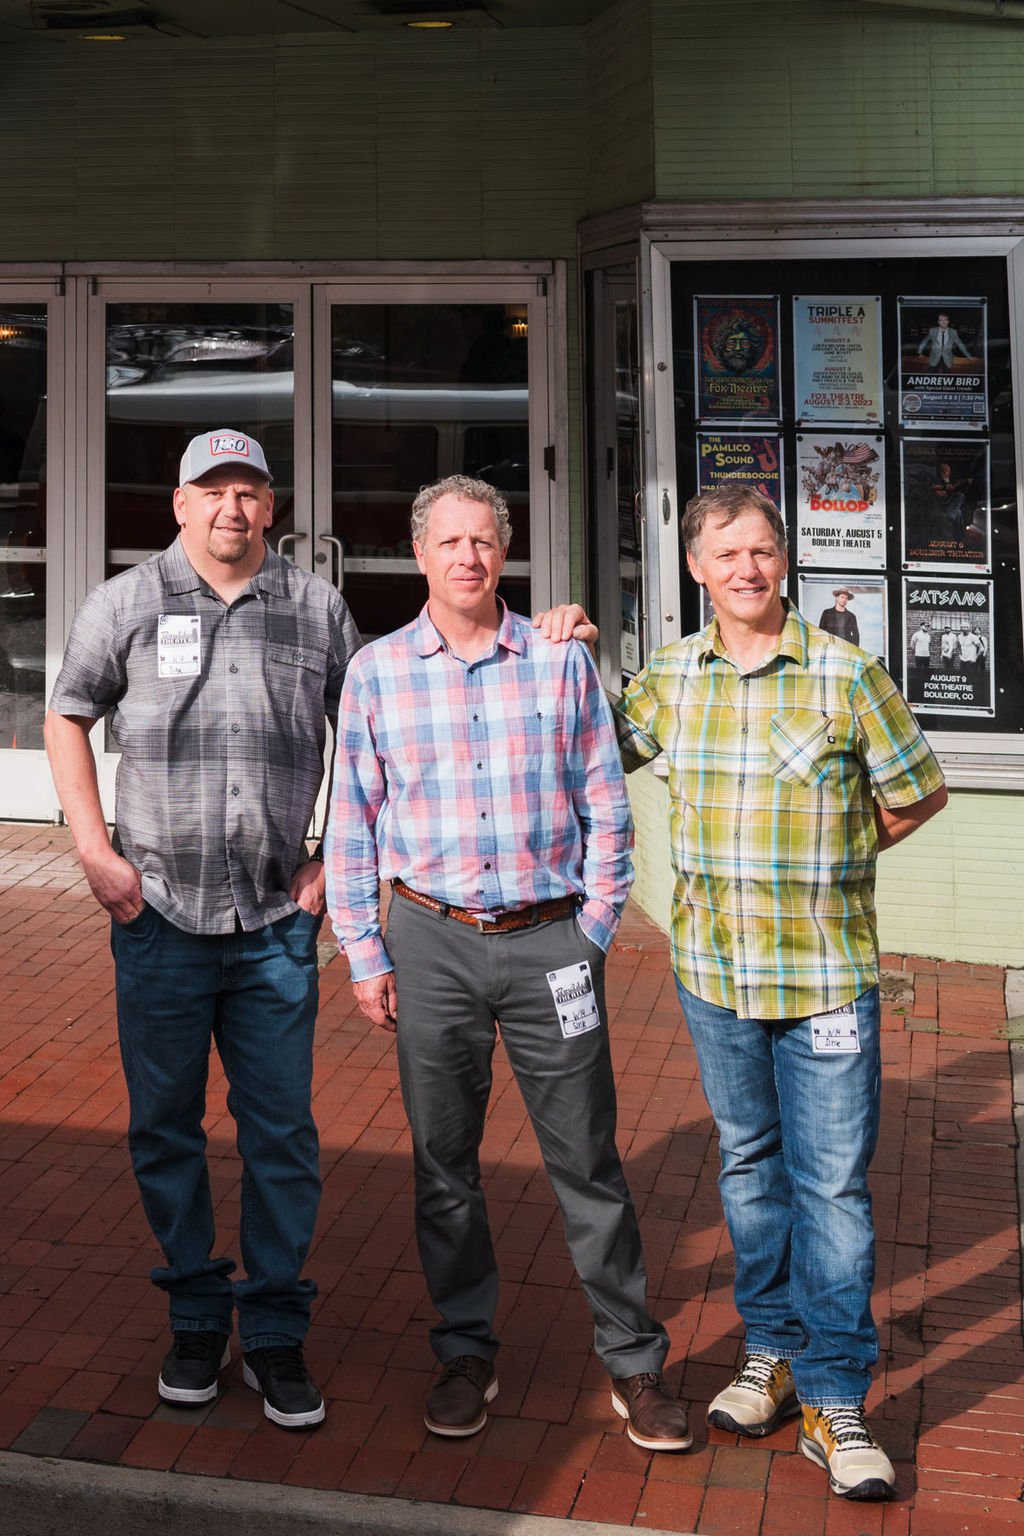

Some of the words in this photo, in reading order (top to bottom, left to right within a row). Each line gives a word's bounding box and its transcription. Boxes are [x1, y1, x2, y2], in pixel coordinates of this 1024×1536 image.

[808, 306, 853, 317] TRIPLE
[857, 307, 866, 317] A
[808, 316, 865, 324] SUMMITFEST
[908, 376, 954, 386] ANDREW
[955, 377, 980, 386] BIRD
[811, 392, 827, 400] FOX
[830, 392, 865, 400] THEATRE
[922, 394, 943, 402] August
[701, 444, 751, 457] PAMLICO
[715, 453, 754, 467] SOUND
[810, 499, 870, 512] DOLLOP
[801, 527, 844, 539] SATURDAY,
[846, 528, 875, 539] AUGUST
[877, 530, 883, 539] 5
[812, 538, 841, 547] BOULDER
[843, 539, 871, 548] THEATER
[941, 683, 974, 691] THEATRE
[924, 691, 961, 700] BOULDER,
